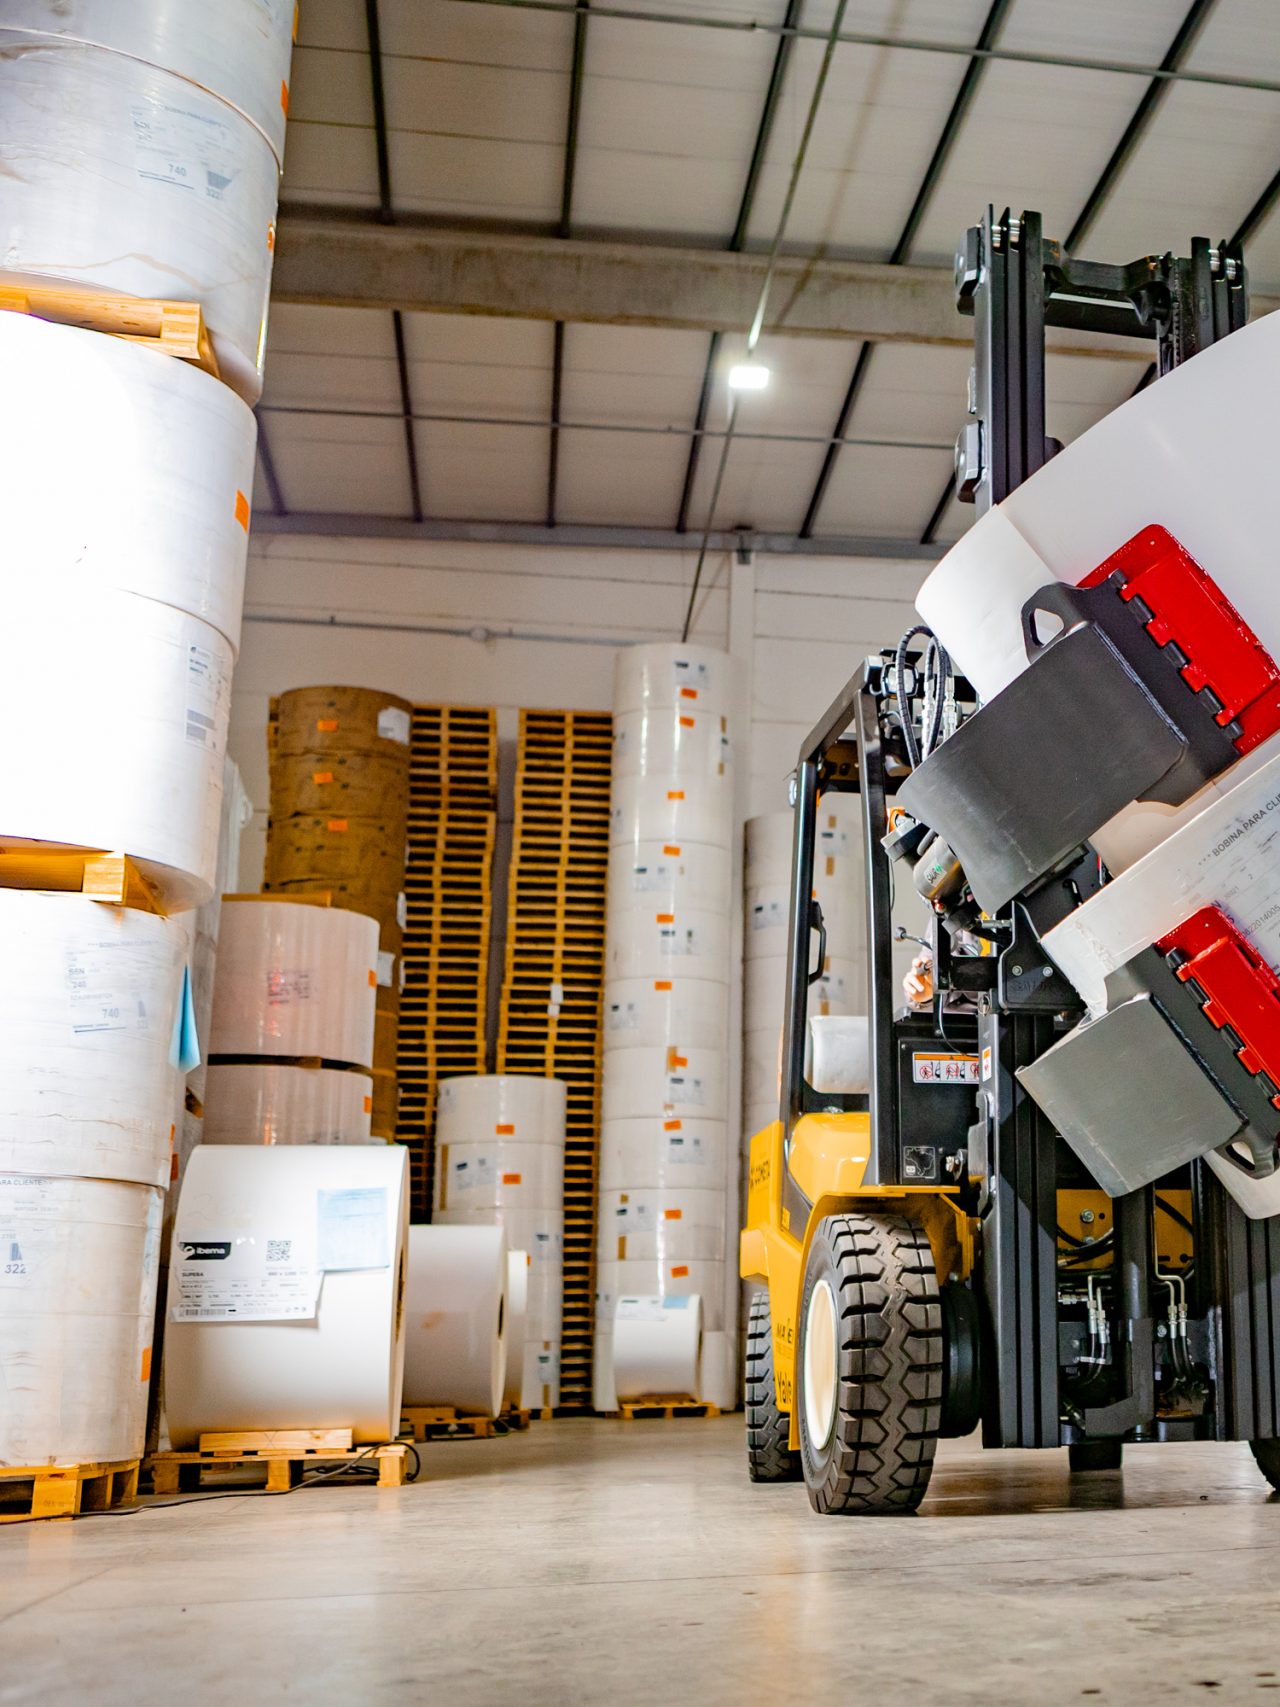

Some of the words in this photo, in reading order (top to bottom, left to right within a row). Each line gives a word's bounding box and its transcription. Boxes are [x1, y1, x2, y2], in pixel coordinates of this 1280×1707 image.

[168, 163, 187, 177] 740
[1212, 828, 1244, 857] BOBINA
[1243, 809, 1267, 831] PARA
[102, 1008, 119, 1019] 740
[196, 1246, 226, 1255] ibema
